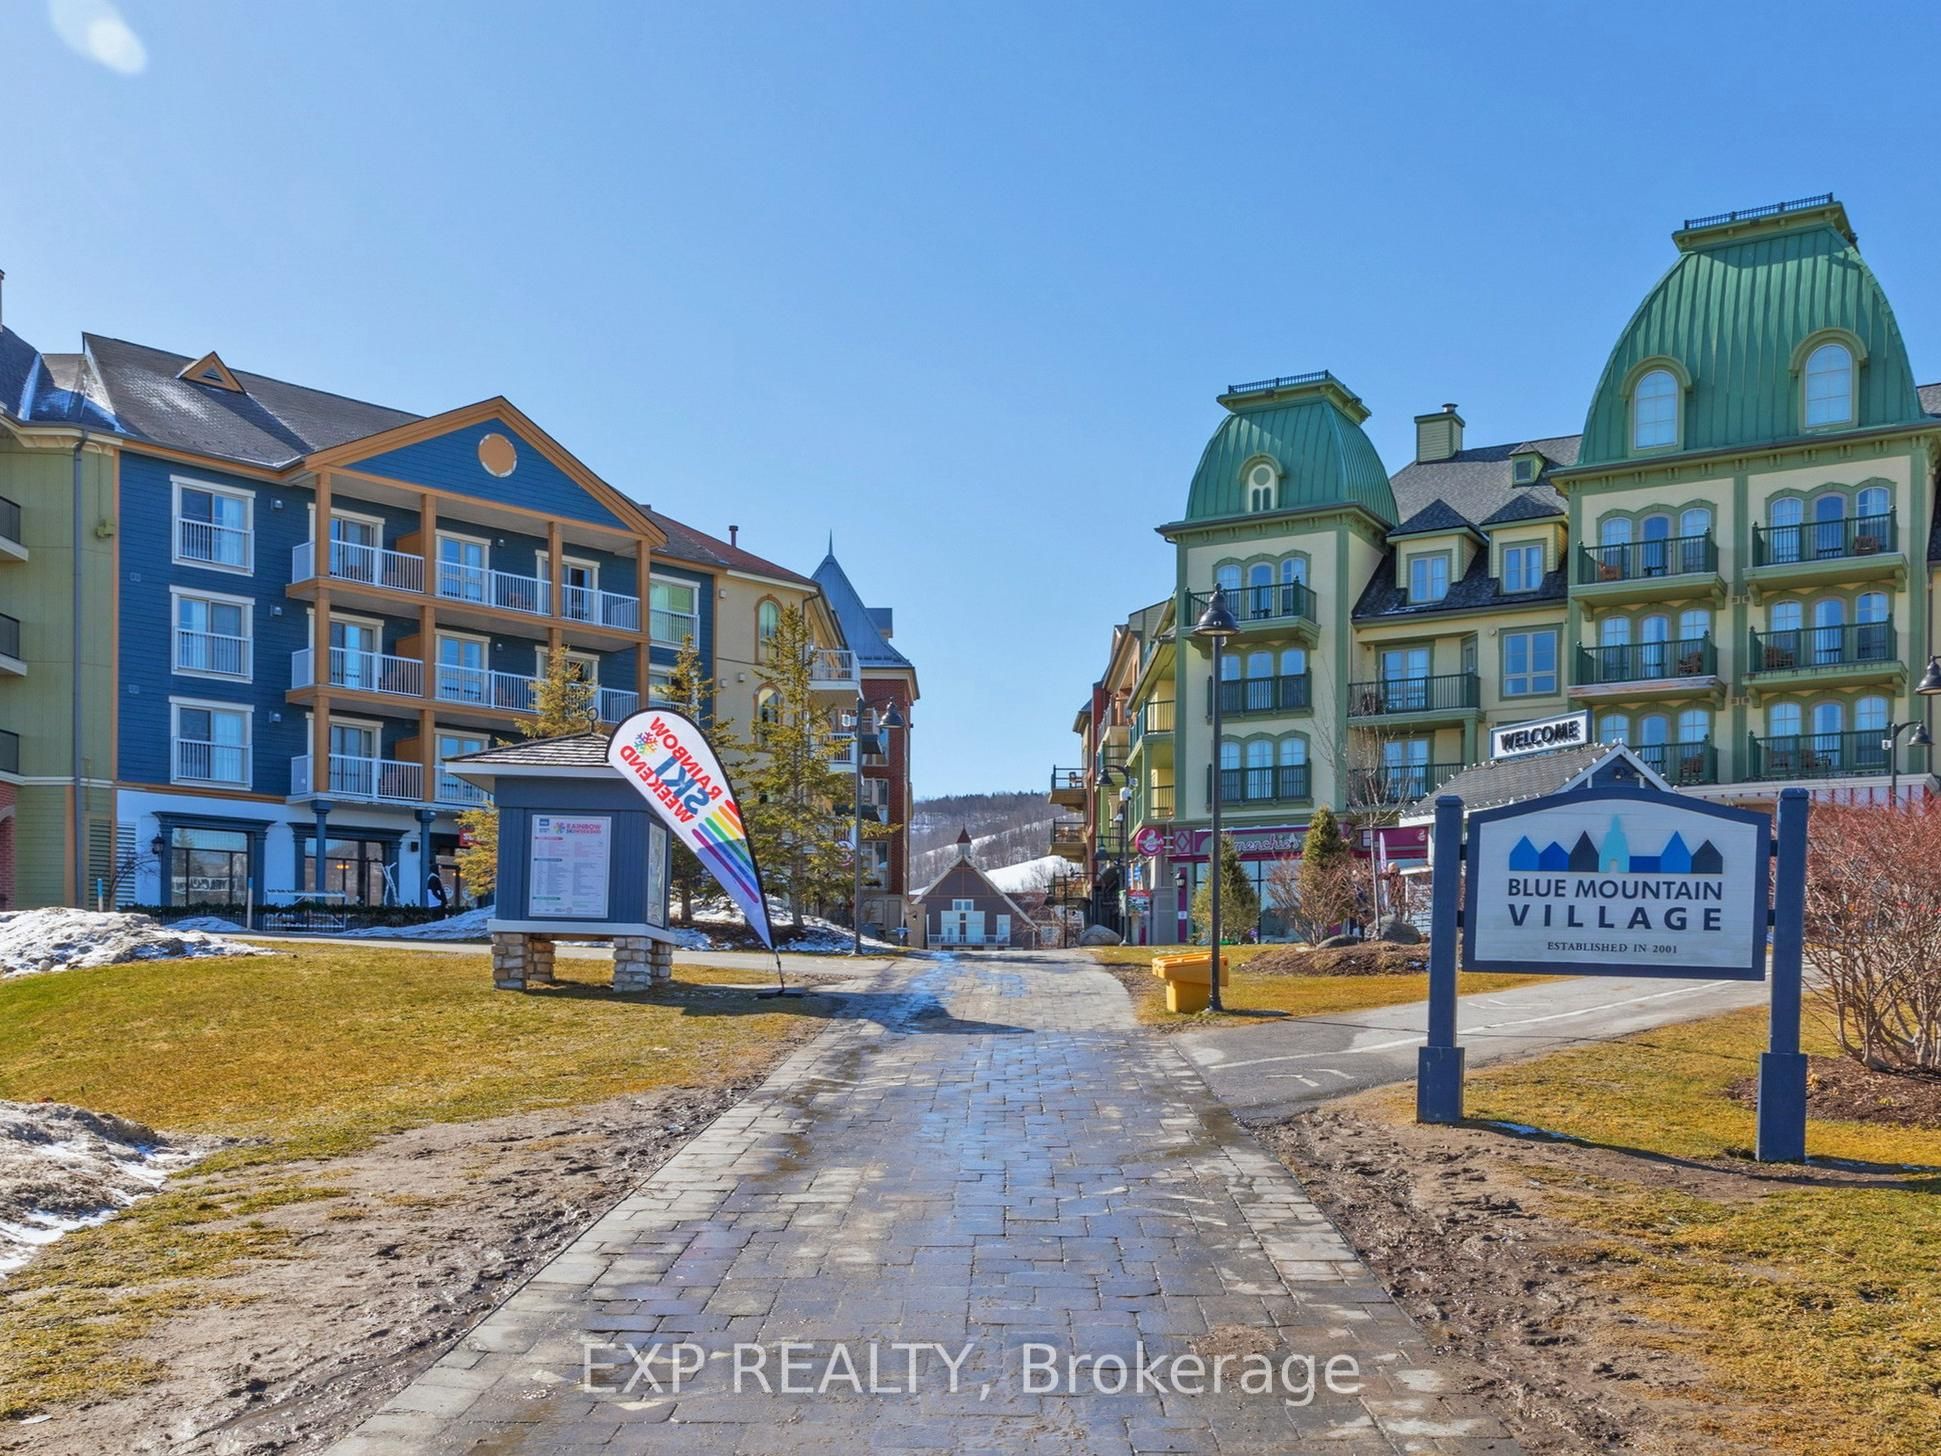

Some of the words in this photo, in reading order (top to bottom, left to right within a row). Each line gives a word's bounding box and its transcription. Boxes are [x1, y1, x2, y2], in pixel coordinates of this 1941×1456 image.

[1500, 720, 1580, 753] WELCOME
[1507, 878, 1567, 897] BLUE
[1575, 879, 1723, 901] MOUNTAIN
[1508, 903, 1722, 932] VILLAGE
[1547, 941, 1628, 953] ESTABLISHED
[1633, 944, 1648, 953] IN
[1652, 944, 1678, 954] 2001
